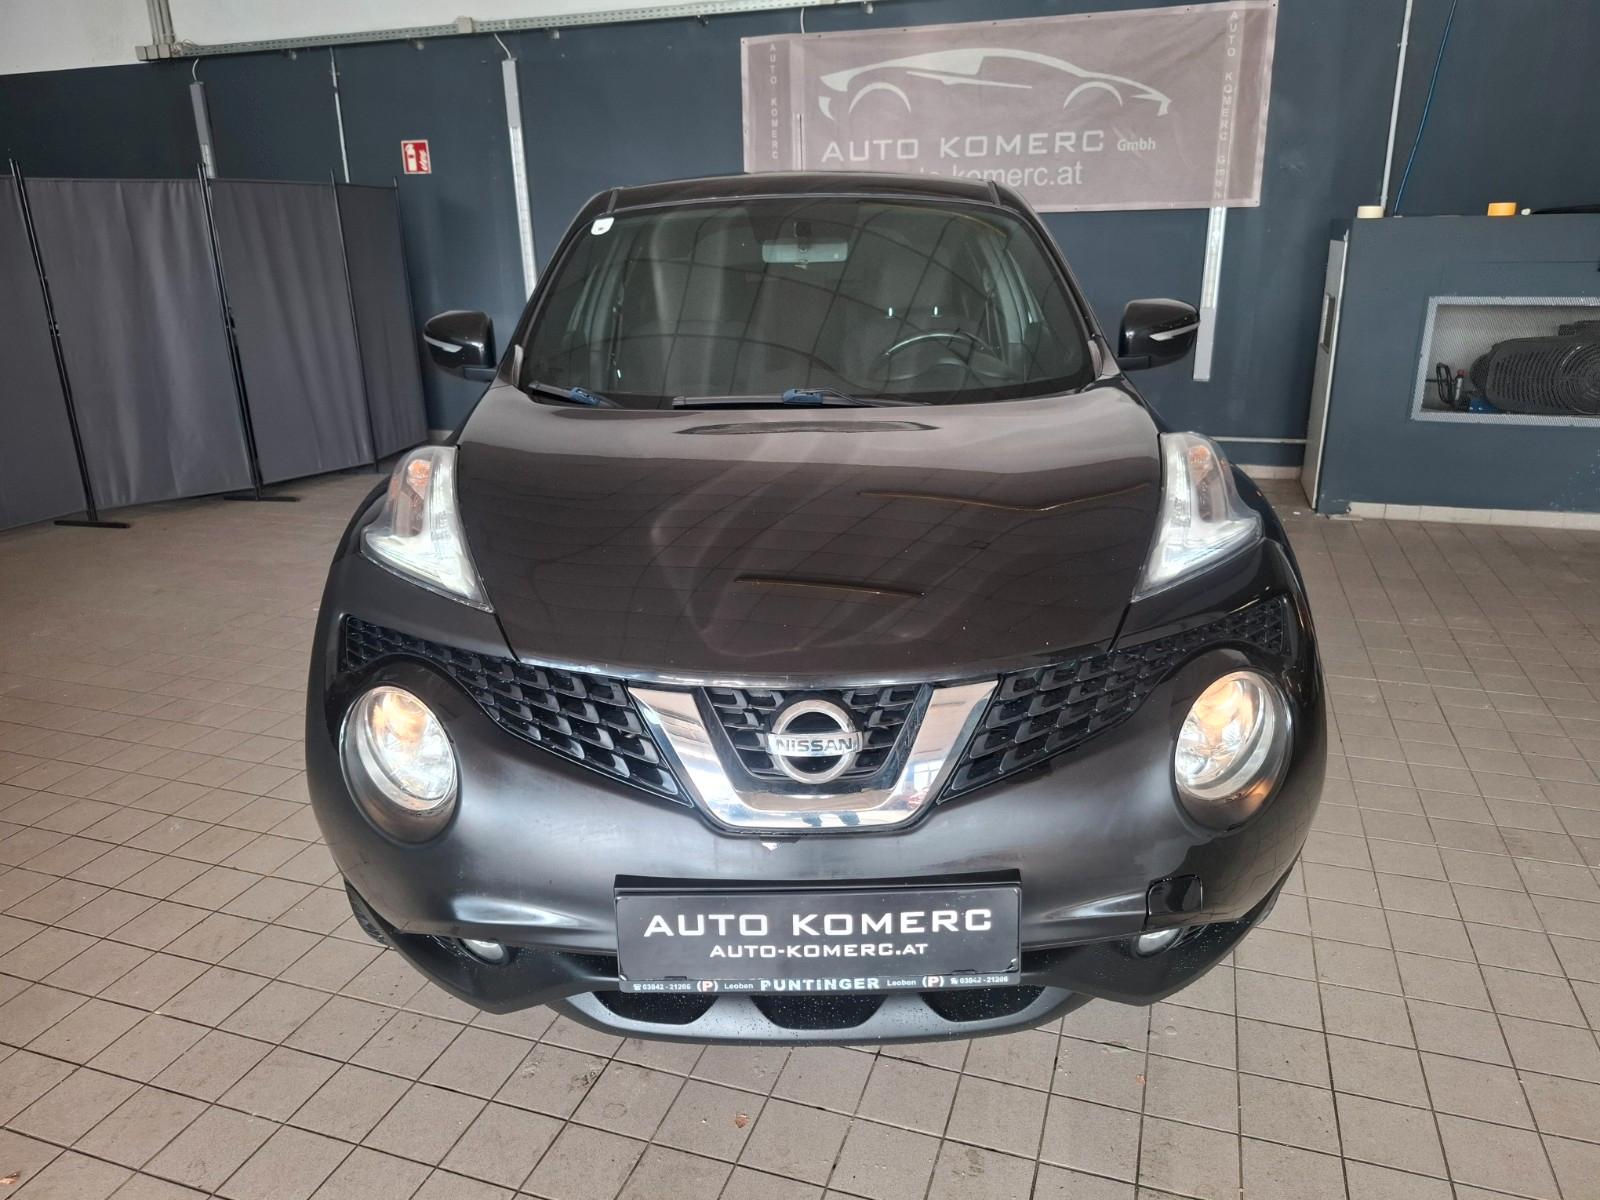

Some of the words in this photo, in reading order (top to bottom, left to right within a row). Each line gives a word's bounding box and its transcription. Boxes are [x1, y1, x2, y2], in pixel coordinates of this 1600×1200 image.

[1227, 10, 1239, 57] AUTO
[769, 43, 778, 85] AUTO
[821, 138, 919, 163] AUTO
[939, 129, 1105, 159] KOMERC
[1116, 136, 1157, 152] Gmbh
[775, 737, 852, 753] NISSAN
[643, 913, 769, 938] AUTO
[792, 908, 992, 937] KOMERC
[709, 942, 929, 959] AUTO-KOMERC.AT
[724, 980, 754, 990] Leoben
[760, 978, 880, 992] PUNTINGER
[886, 978, 917, 987] Leoben
